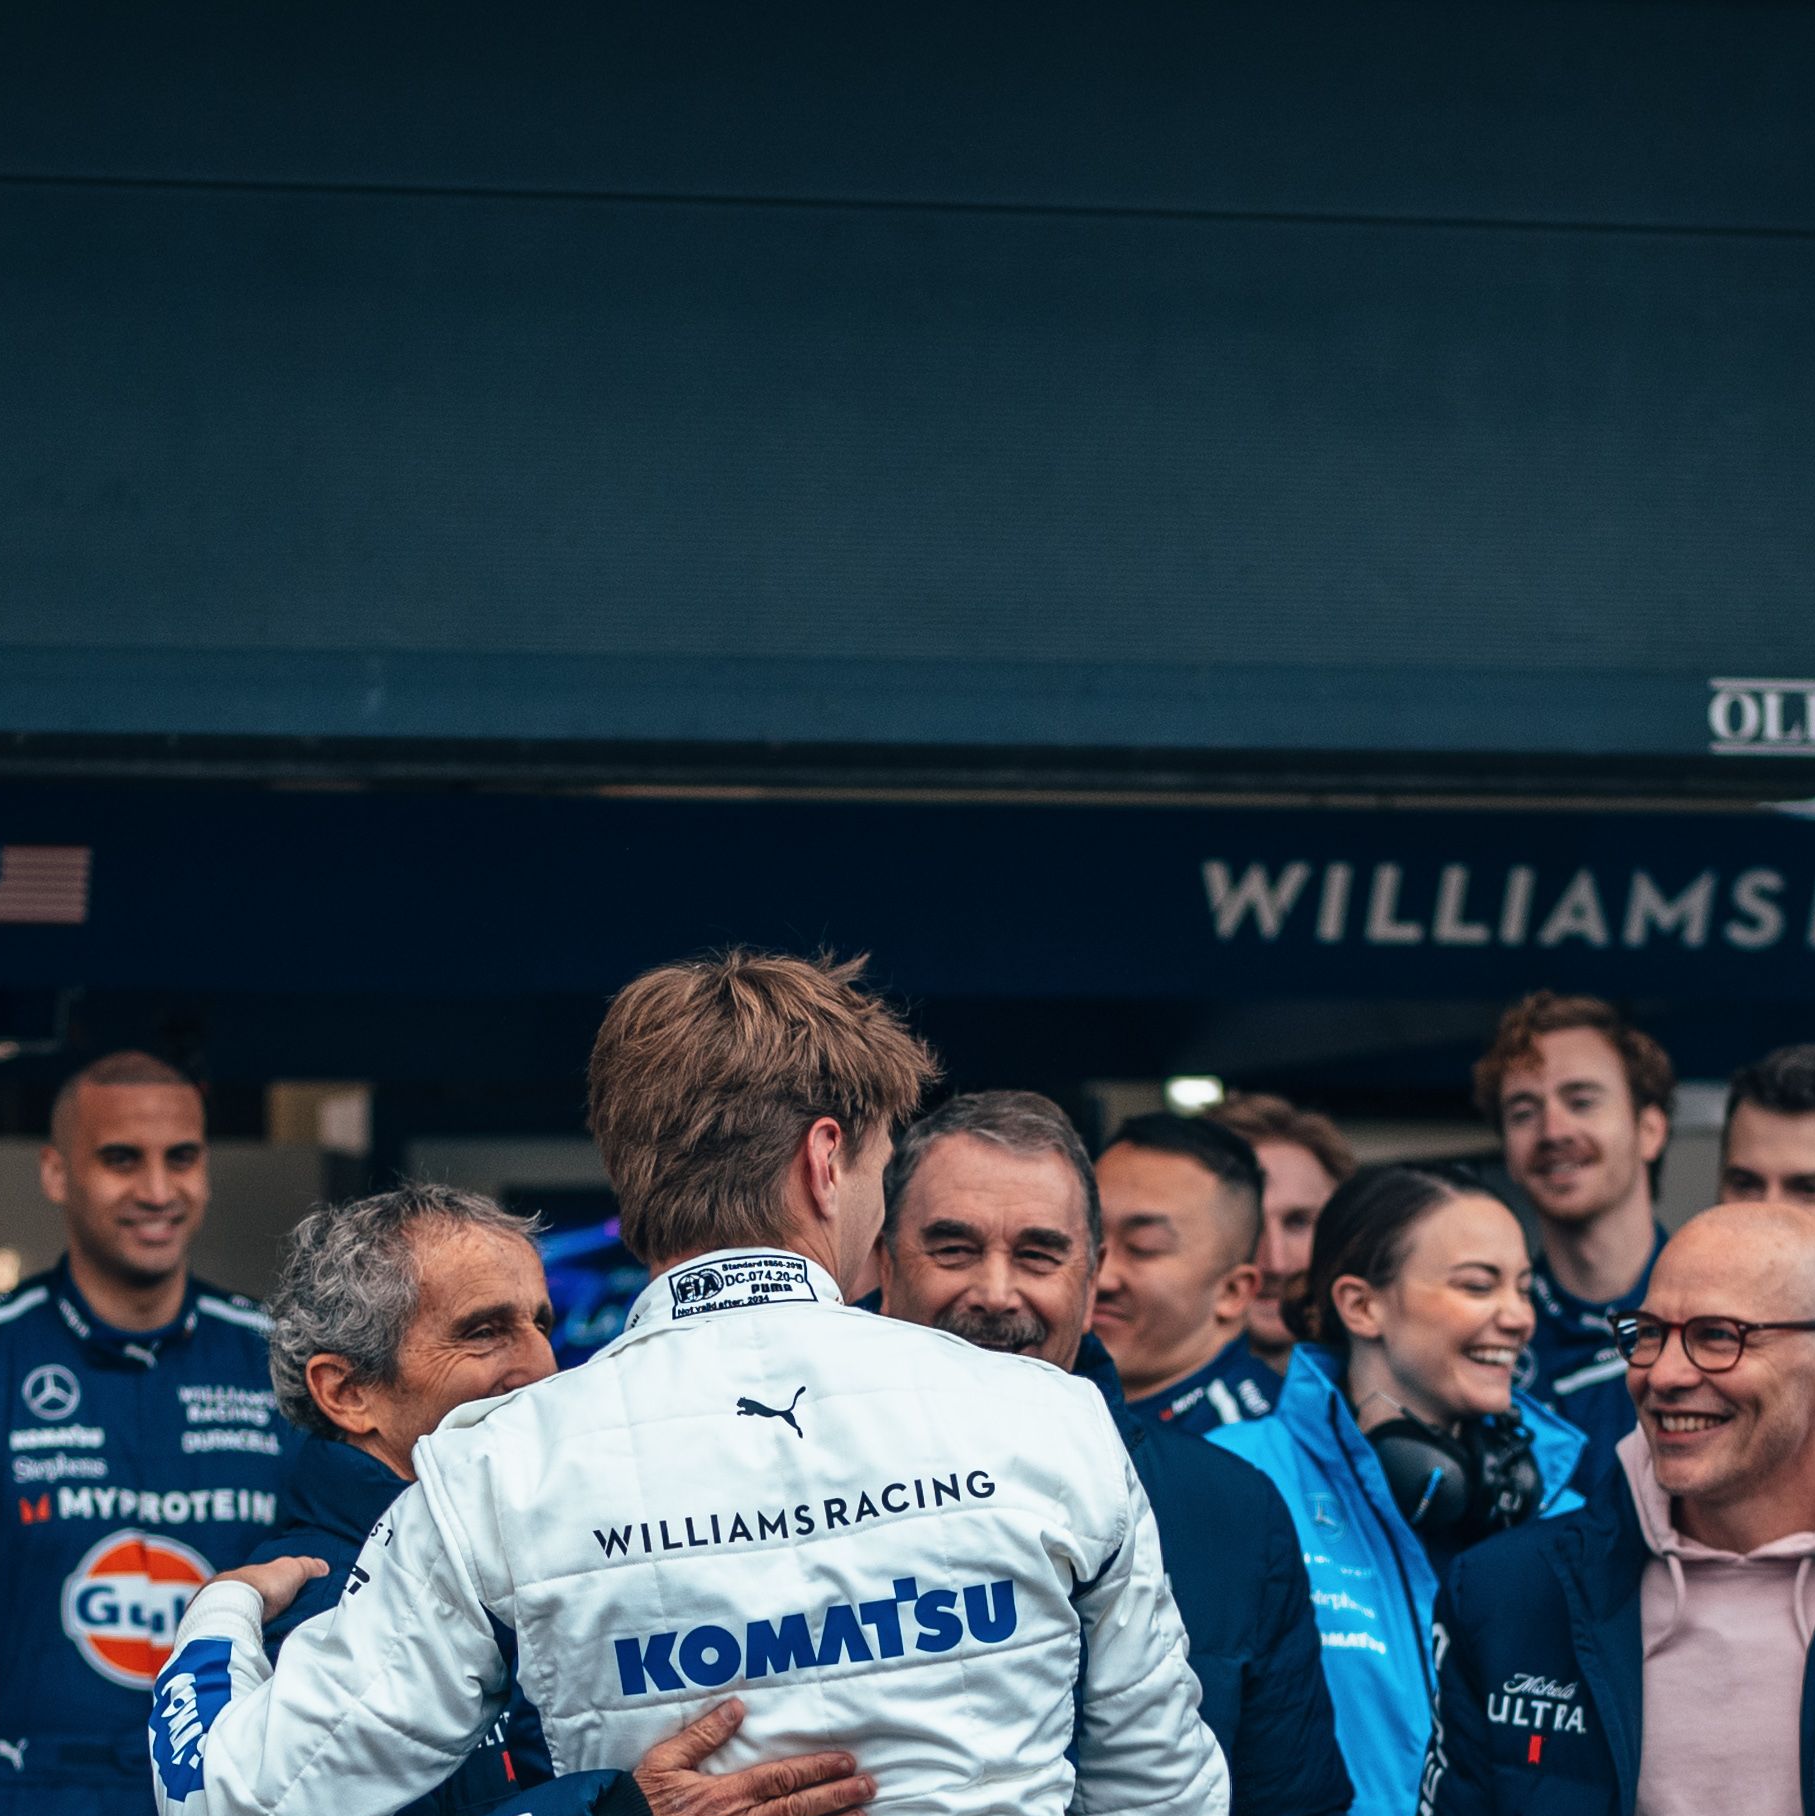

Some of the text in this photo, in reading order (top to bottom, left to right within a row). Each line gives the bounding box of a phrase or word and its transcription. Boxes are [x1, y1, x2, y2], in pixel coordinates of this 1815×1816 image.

[722, 1260, 763, 1271] Standard
[678, 1272, 717, 1301] FIA
[57, 1486, 277, 1526] MYPROTEIN
[74, 1584, 186, 1633] Gul
[613, 1576, 1018, 1697] KOMATSU
[1487, 1692, 1586, 1735] ULTRA
